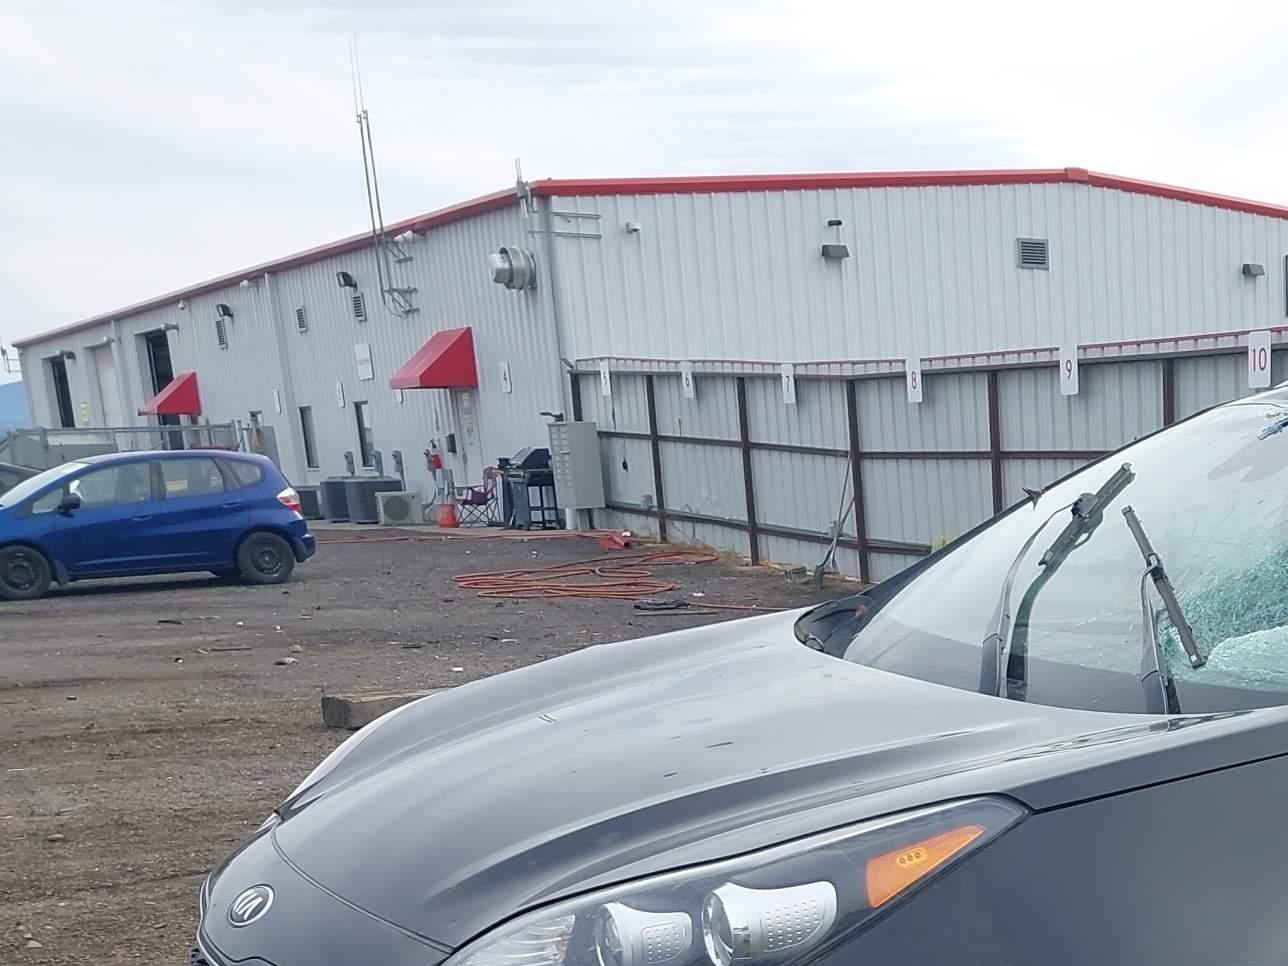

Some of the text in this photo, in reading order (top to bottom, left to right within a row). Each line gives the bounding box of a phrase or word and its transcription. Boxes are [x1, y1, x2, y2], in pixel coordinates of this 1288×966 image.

[1251, 347, 1267, 372] 10
[1065, 359, 1073, 380] 9
[685, 374, 690, 388] 6
[784, 375, 790, 393] 7
[910, 371, 918, 390] 8
